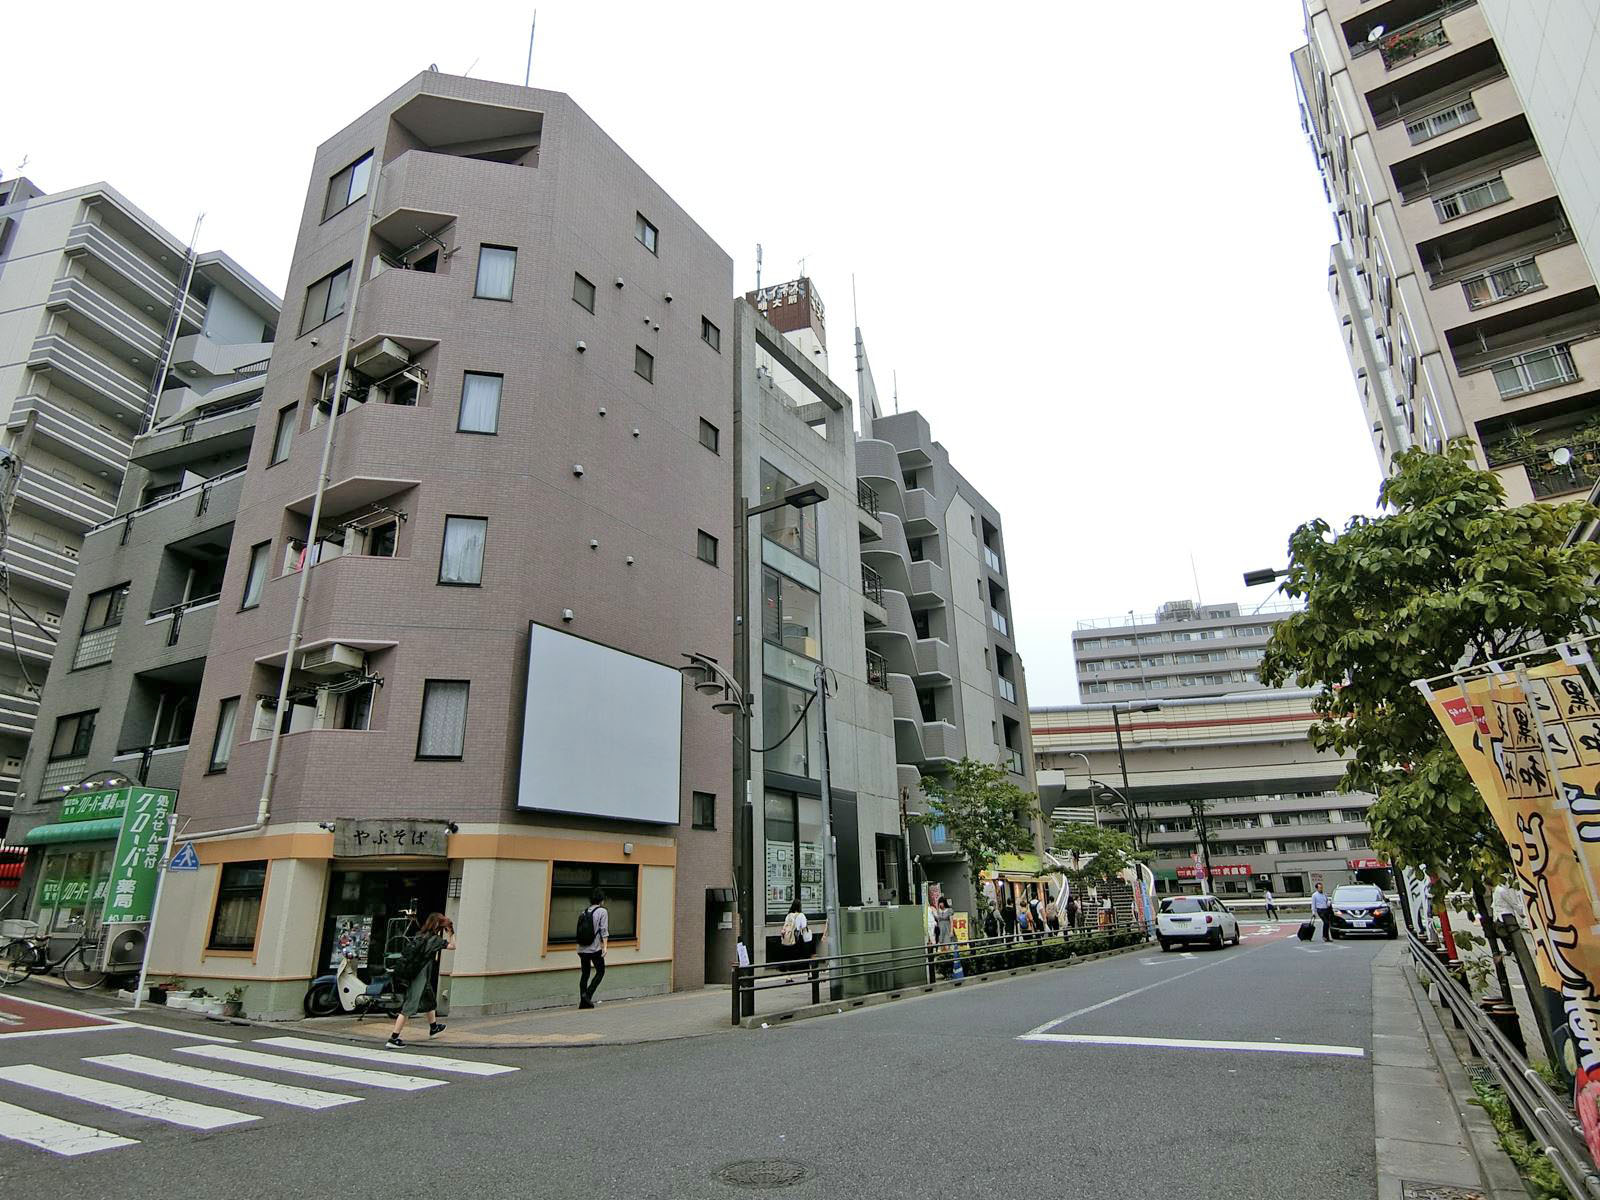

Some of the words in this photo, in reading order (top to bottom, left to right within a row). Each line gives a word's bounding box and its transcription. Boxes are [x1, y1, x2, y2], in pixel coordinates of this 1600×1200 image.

[111, 793, 155, 909] クローバー薬局
[144, 794, 170, 869] 処方せん受付
[353, 829, 428, 846] やぶそば
